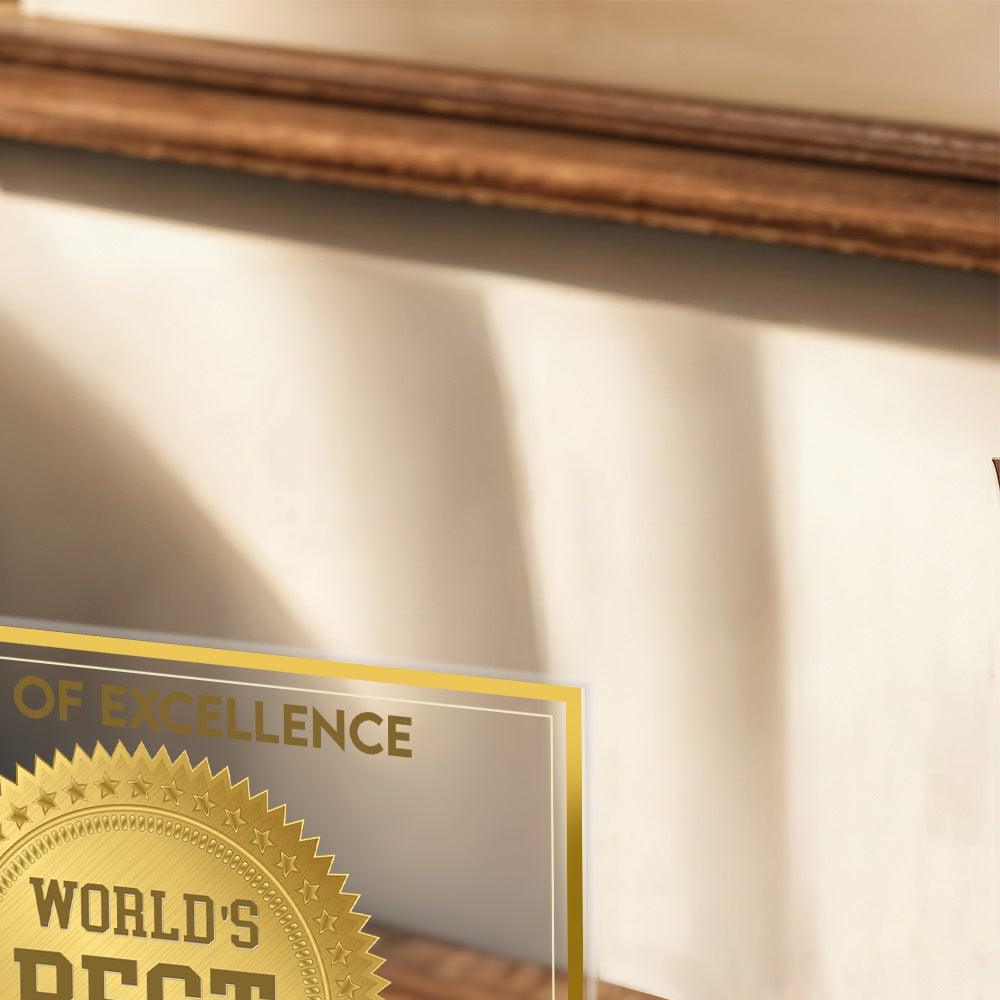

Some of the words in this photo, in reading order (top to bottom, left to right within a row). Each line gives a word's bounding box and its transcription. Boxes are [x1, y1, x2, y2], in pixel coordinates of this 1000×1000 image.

[13, 675, 84, 721] OF
[101, 684, 413, 758] EXCELLENCE
[29, 876, 259, 949] WORLD'S
